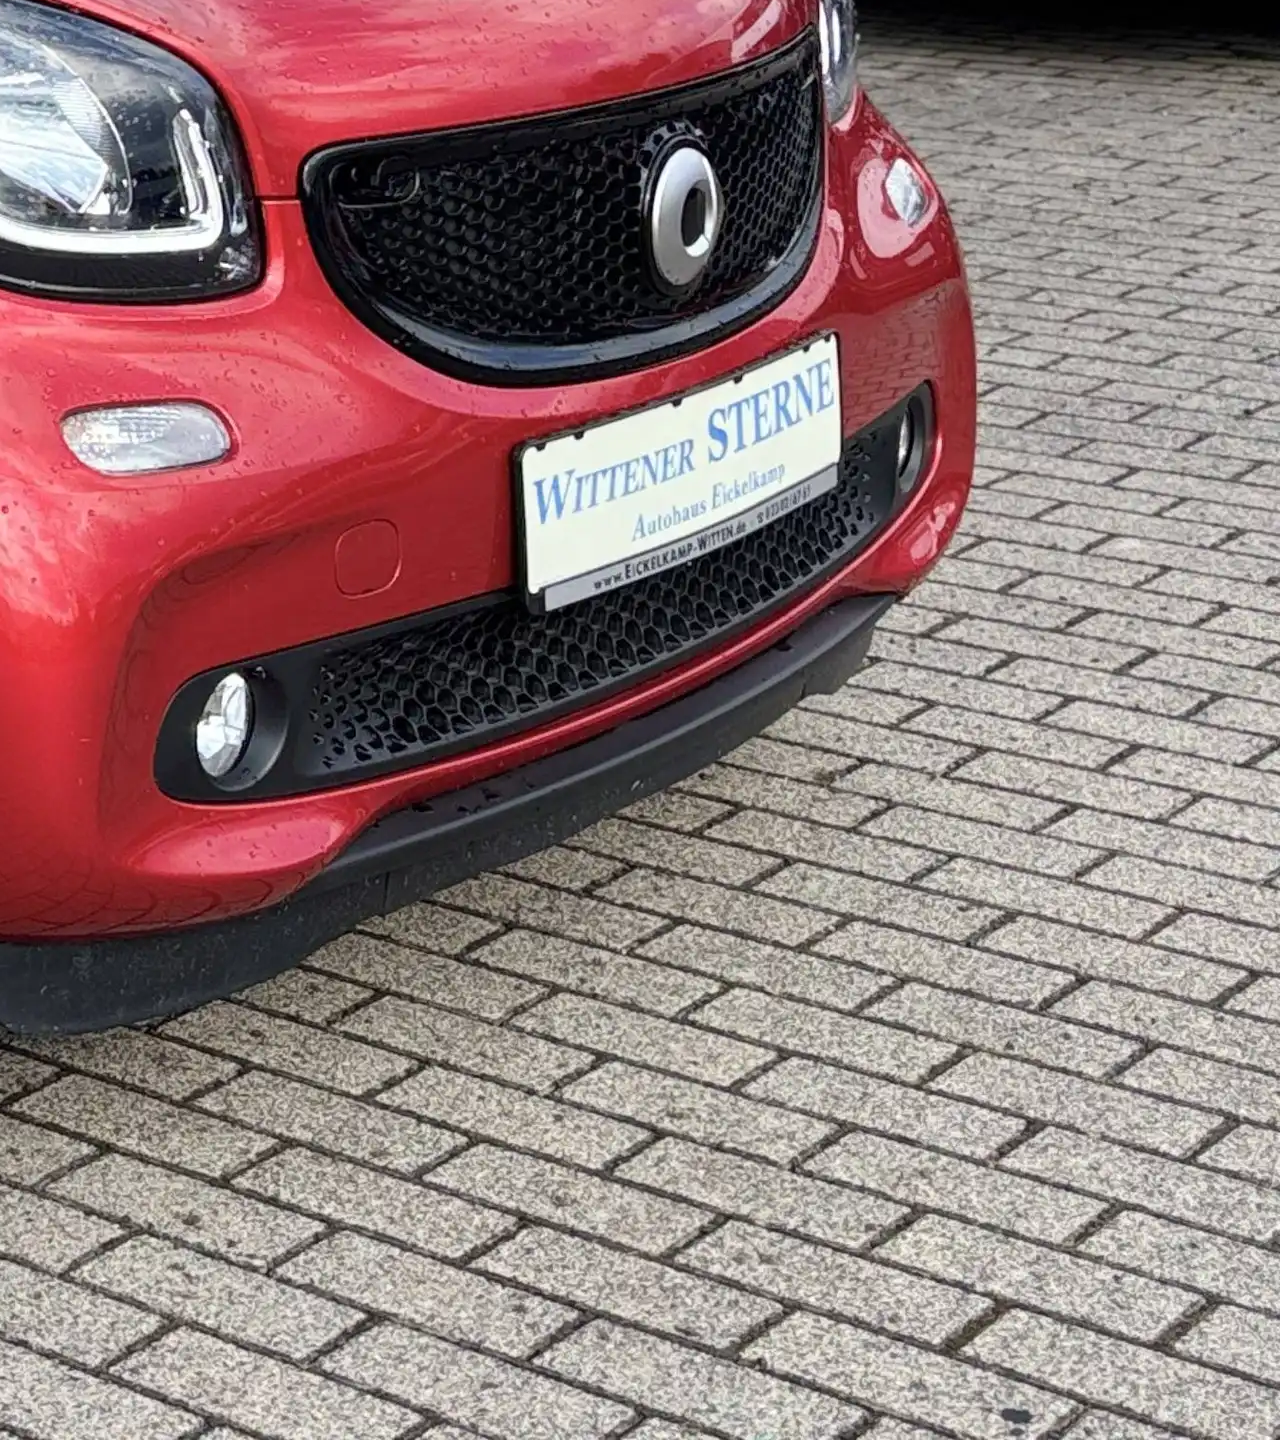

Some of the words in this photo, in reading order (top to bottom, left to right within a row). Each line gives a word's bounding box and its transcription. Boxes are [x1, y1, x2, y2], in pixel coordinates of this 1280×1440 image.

[532, 438, 695, 525] WITTENER
[707, 358, 835, 465] STERNE
[631, 498, 707, 542] Autohaus
[711, 463, 785, 510] Eickelkamp
